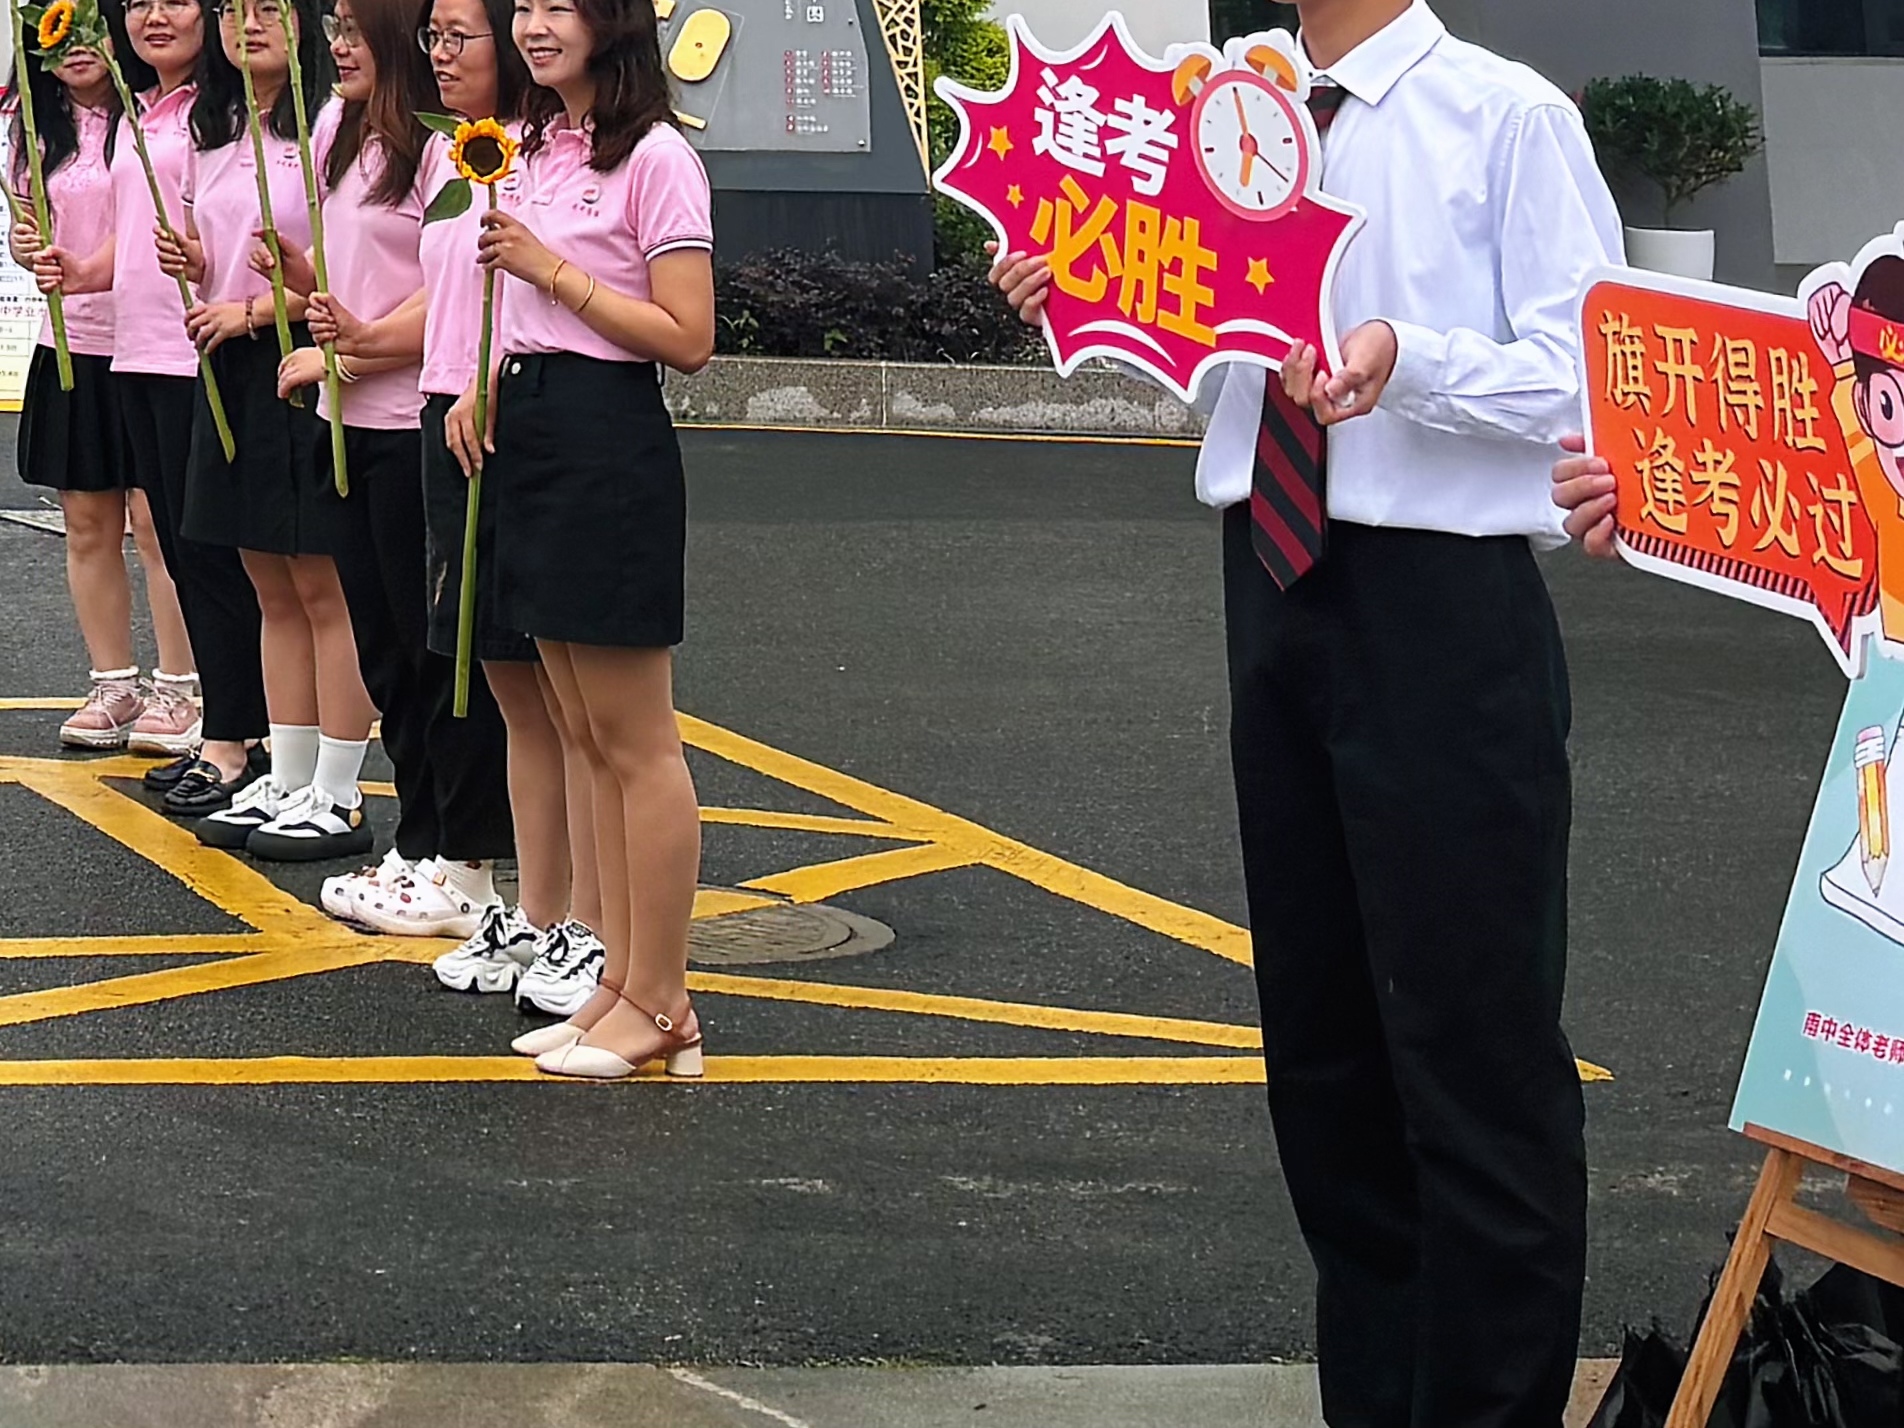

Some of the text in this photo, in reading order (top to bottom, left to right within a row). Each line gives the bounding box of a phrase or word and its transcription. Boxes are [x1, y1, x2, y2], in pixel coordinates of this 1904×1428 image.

[1031, 66, 1179, 198] 逢考
[1029, 173, 1218, 349] 必胜
[1597, 309, 1827, 454] 旗开得胜
[1632, 425, 1865, 582] 逢考必过
